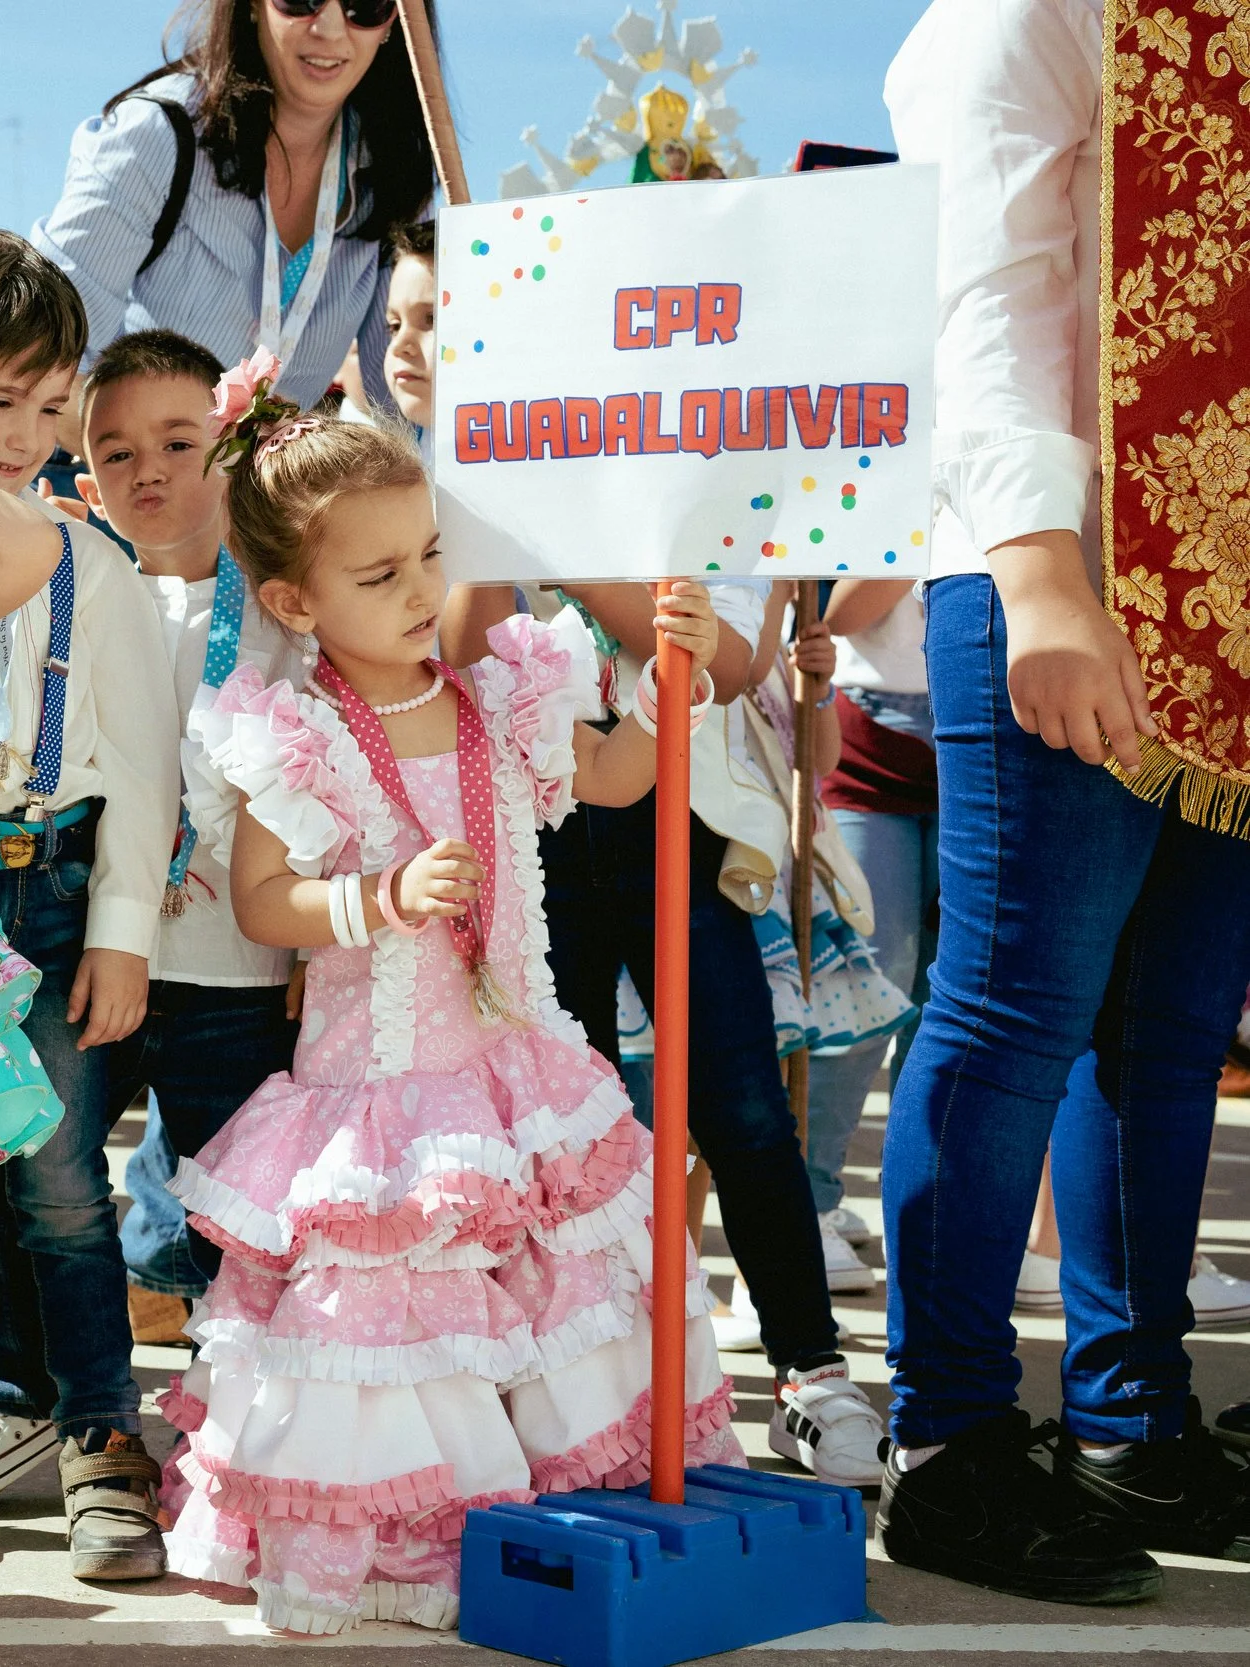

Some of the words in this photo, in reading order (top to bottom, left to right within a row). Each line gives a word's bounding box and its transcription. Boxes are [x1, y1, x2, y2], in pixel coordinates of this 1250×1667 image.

[614, 282, 742, 351] CPR
[455, 383, 908, 464] GUADALQUIVIR
[0, 635, 6, 644] la
[806, 1369, 846, 1385] adidas
